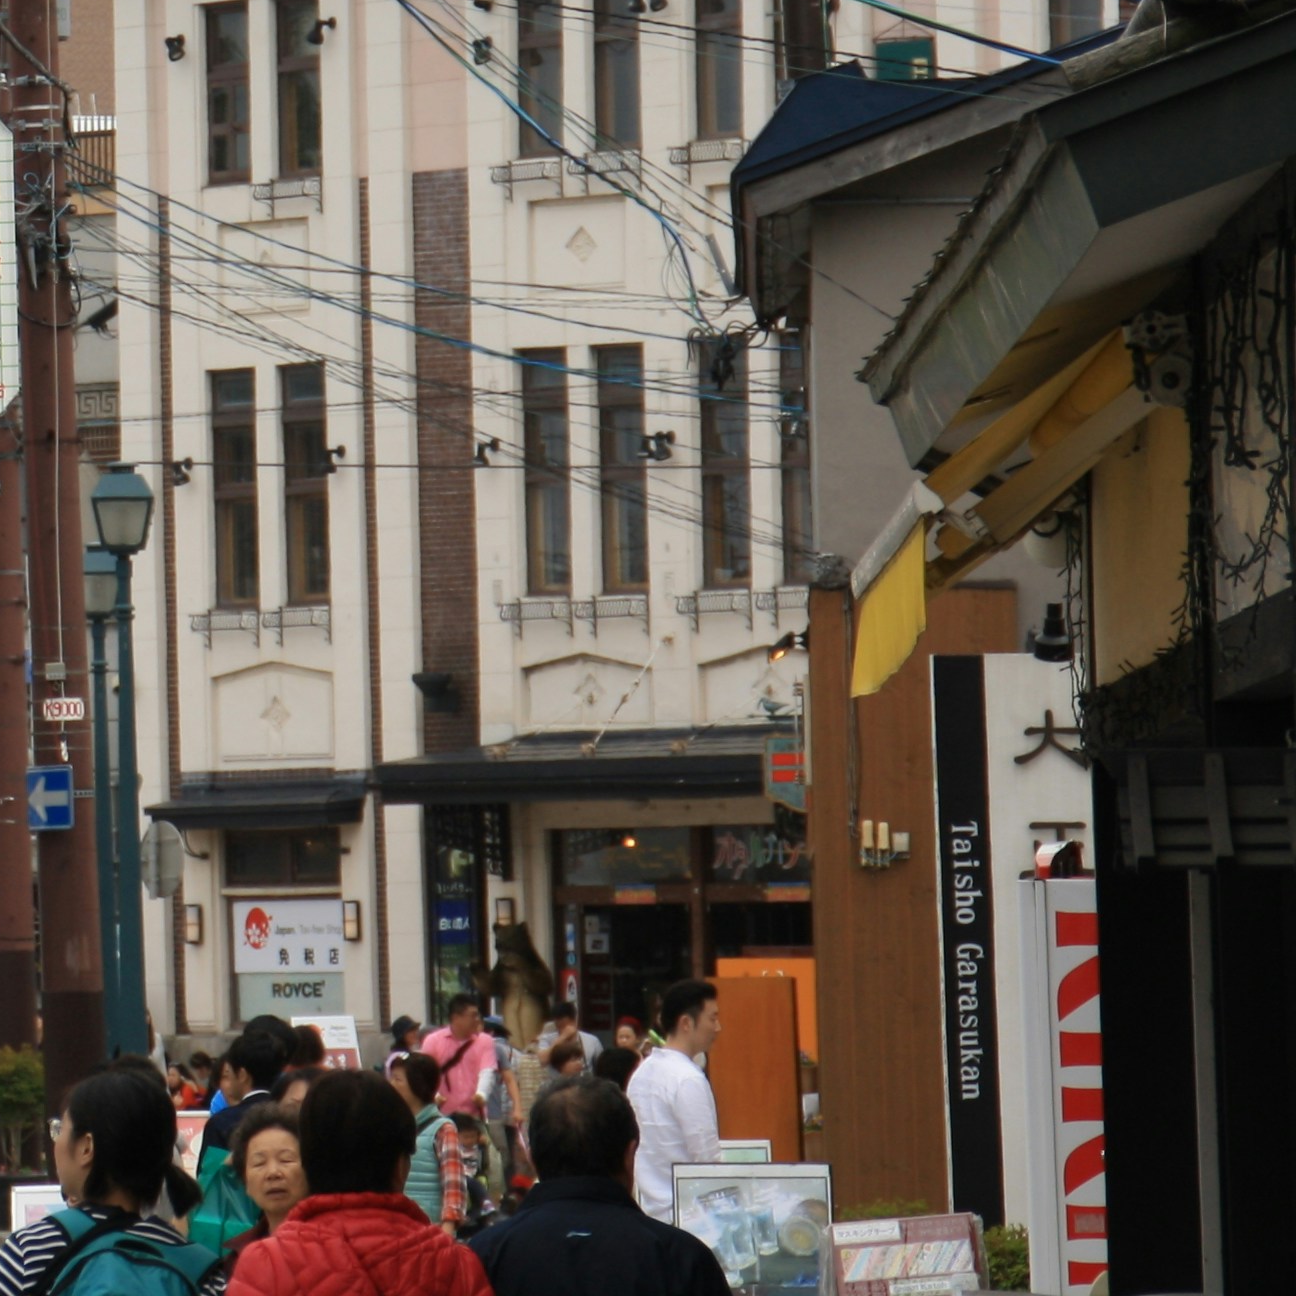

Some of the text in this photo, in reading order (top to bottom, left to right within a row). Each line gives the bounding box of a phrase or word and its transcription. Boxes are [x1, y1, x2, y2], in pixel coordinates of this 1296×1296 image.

[279, 948, 340, 966] 免税店
[951, 820, 985, 1102] Taisho Garasukan
